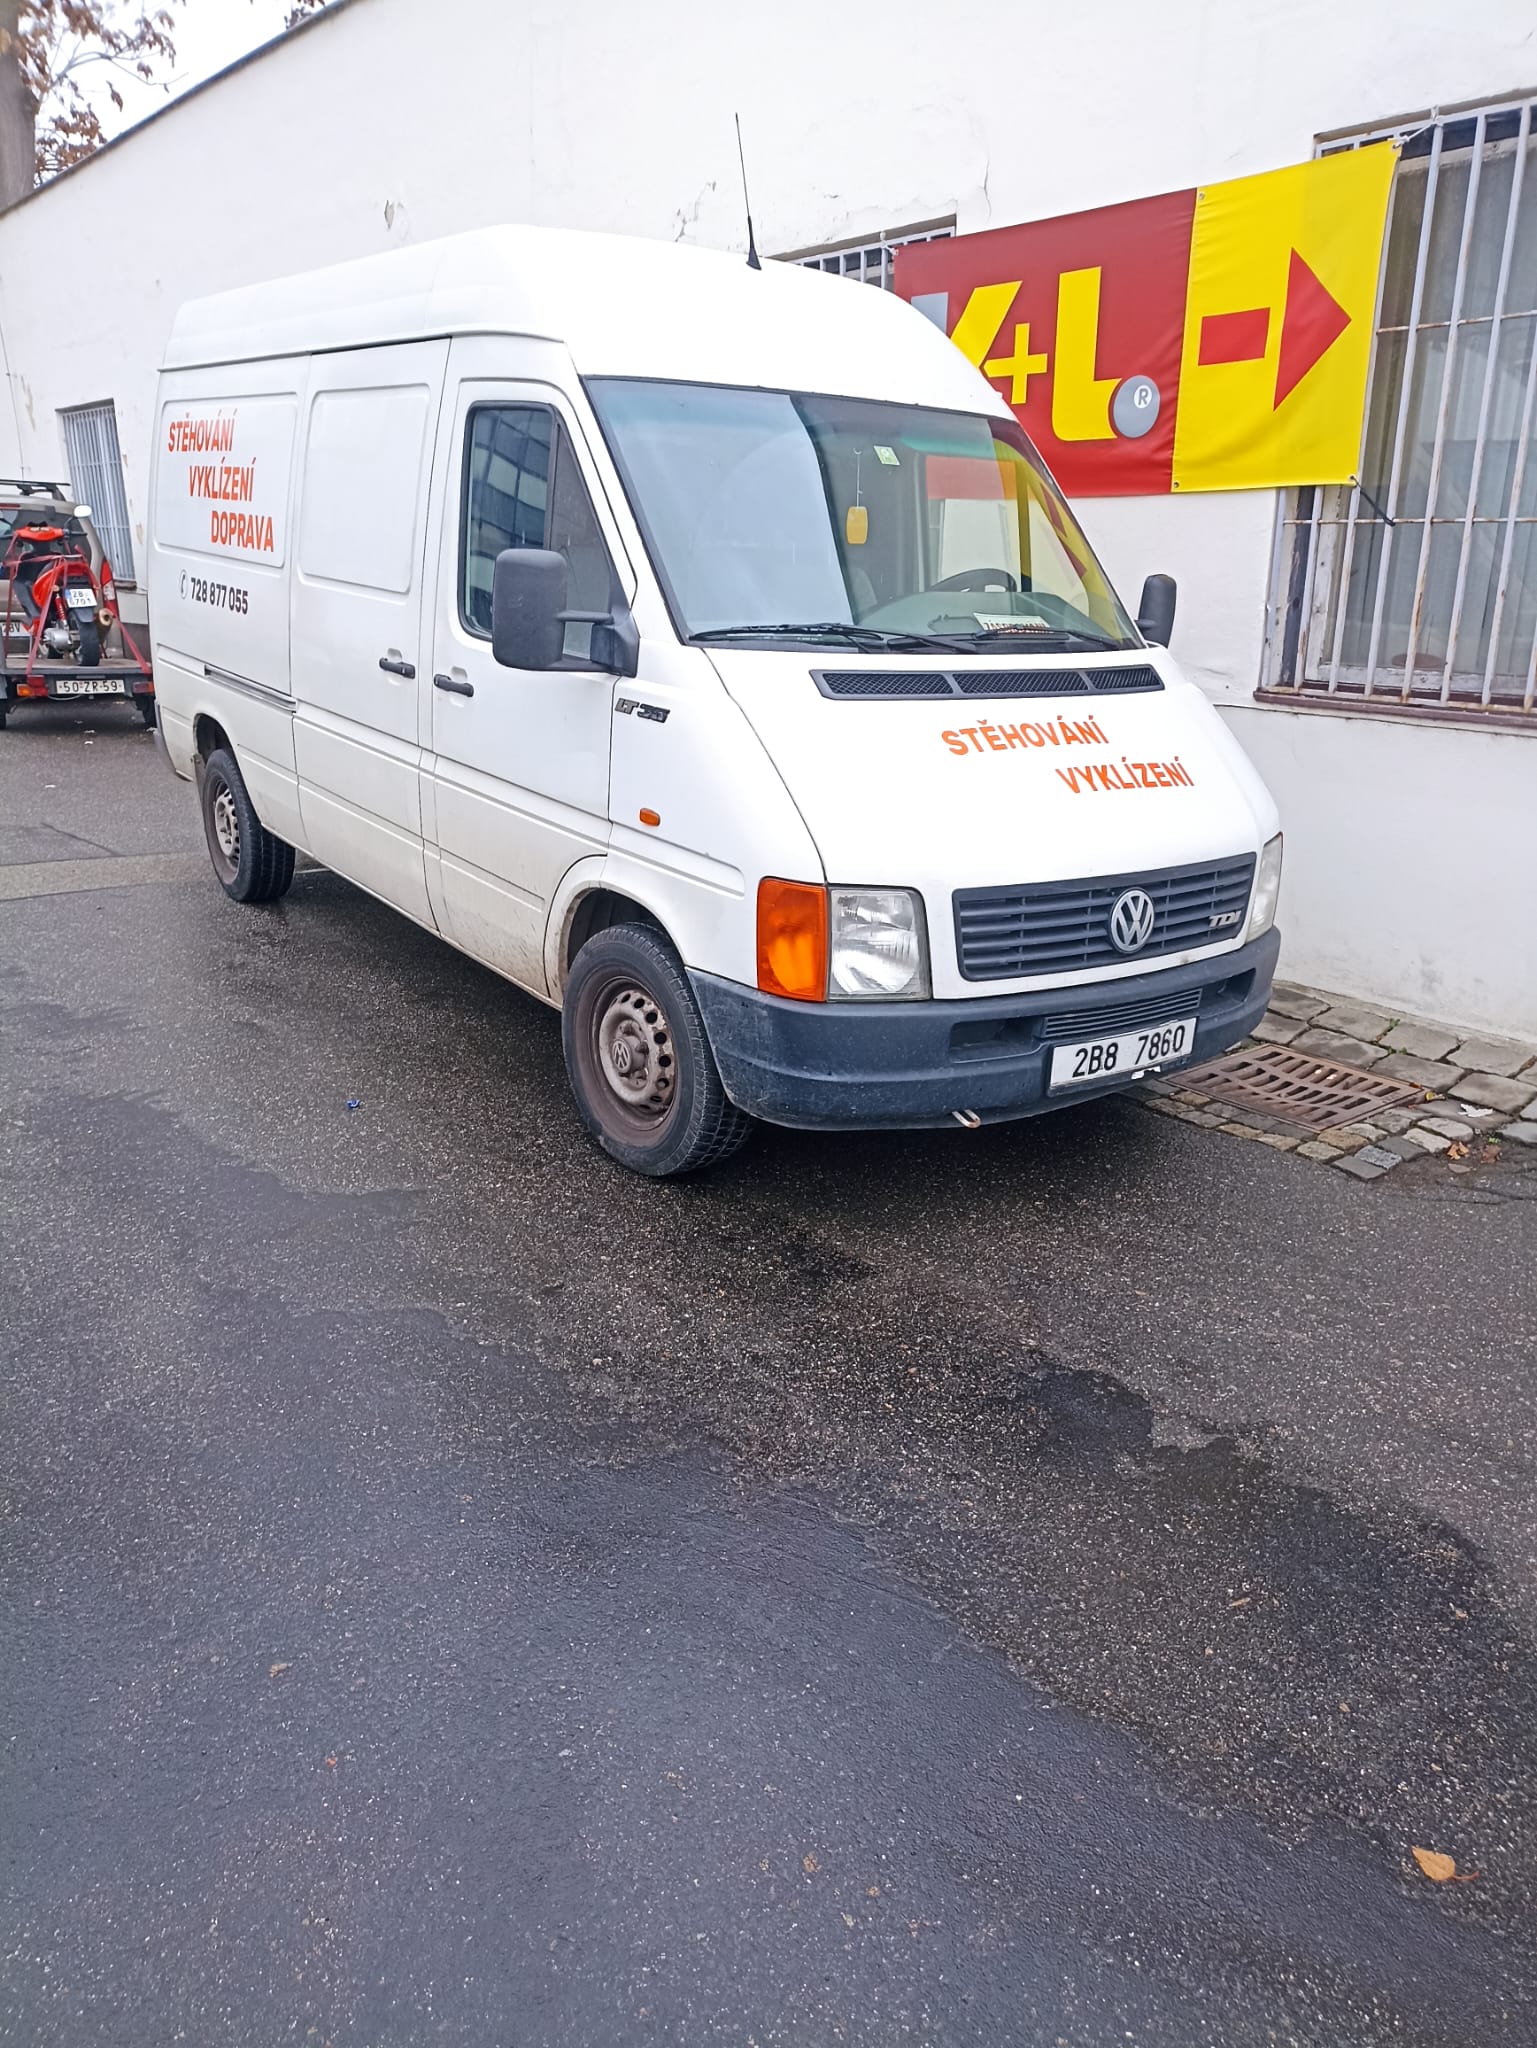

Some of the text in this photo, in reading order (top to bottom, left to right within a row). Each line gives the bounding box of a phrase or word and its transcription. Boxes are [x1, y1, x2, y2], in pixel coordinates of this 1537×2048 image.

[168, 408, 239, 453] STĚHOVÁNÍ
[189, 456, 257, 503] VYKLÍZENÍ
[210, 510, 275, 553] DOPRAVA
[190, 577, 249, 615] 728 877 055
[615, 698, 640, 715] LT
[941, 714, 1110, 756] STĚHOVÁNÍ
[1055, 756, 1195, 794] VYKLÍZENÍ
[1208, 910, 1242, 928] TDI
[1071, 1025, 1185, 1078] 2B8 7860
